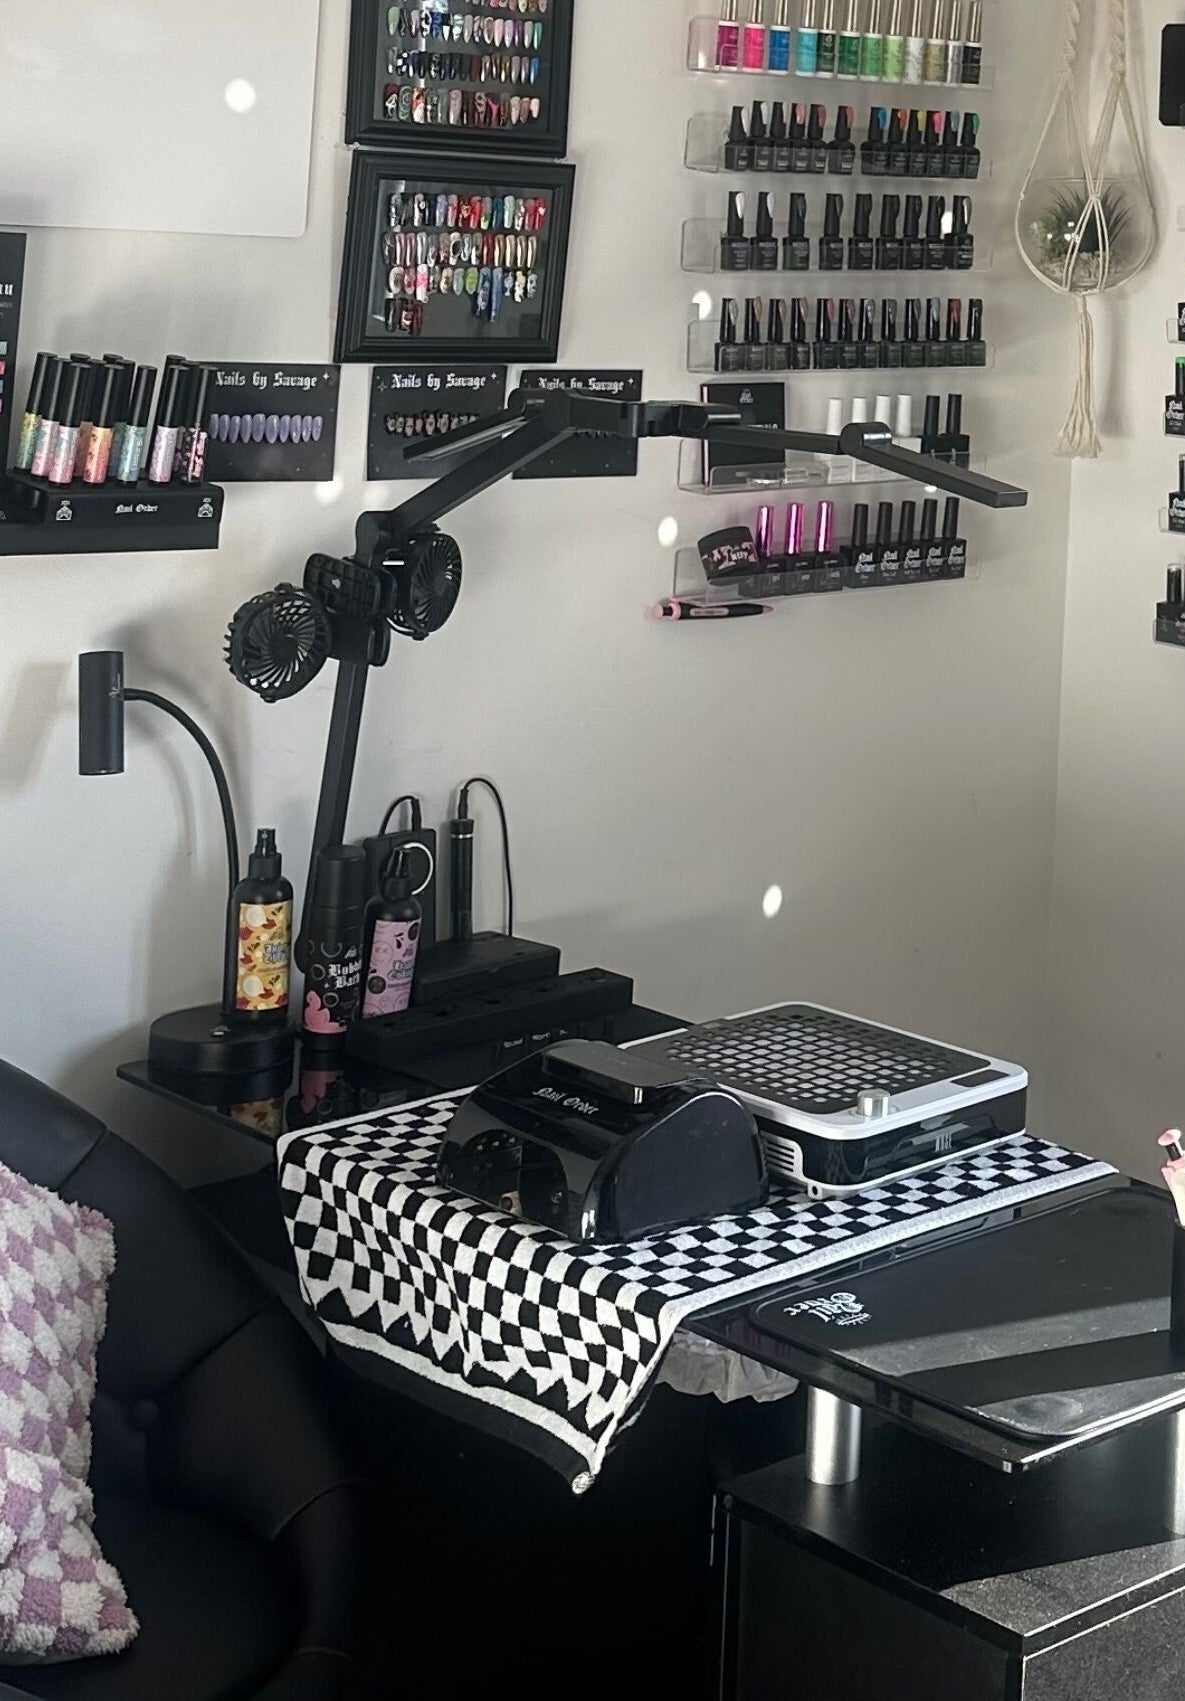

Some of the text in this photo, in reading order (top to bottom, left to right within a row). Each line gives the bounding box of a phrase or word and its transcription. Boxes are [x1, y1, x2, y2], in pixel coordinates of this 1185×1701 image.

[252, 371, 267, 390] by
[273, 371, 318, 391] Savage
[391, 373, 486, 391] Nails by Savage
[539, 377, 565, 390] Nails
[588, 377, 624, 394] Savage
[532, 1087, 599, 1114] Nail Order
